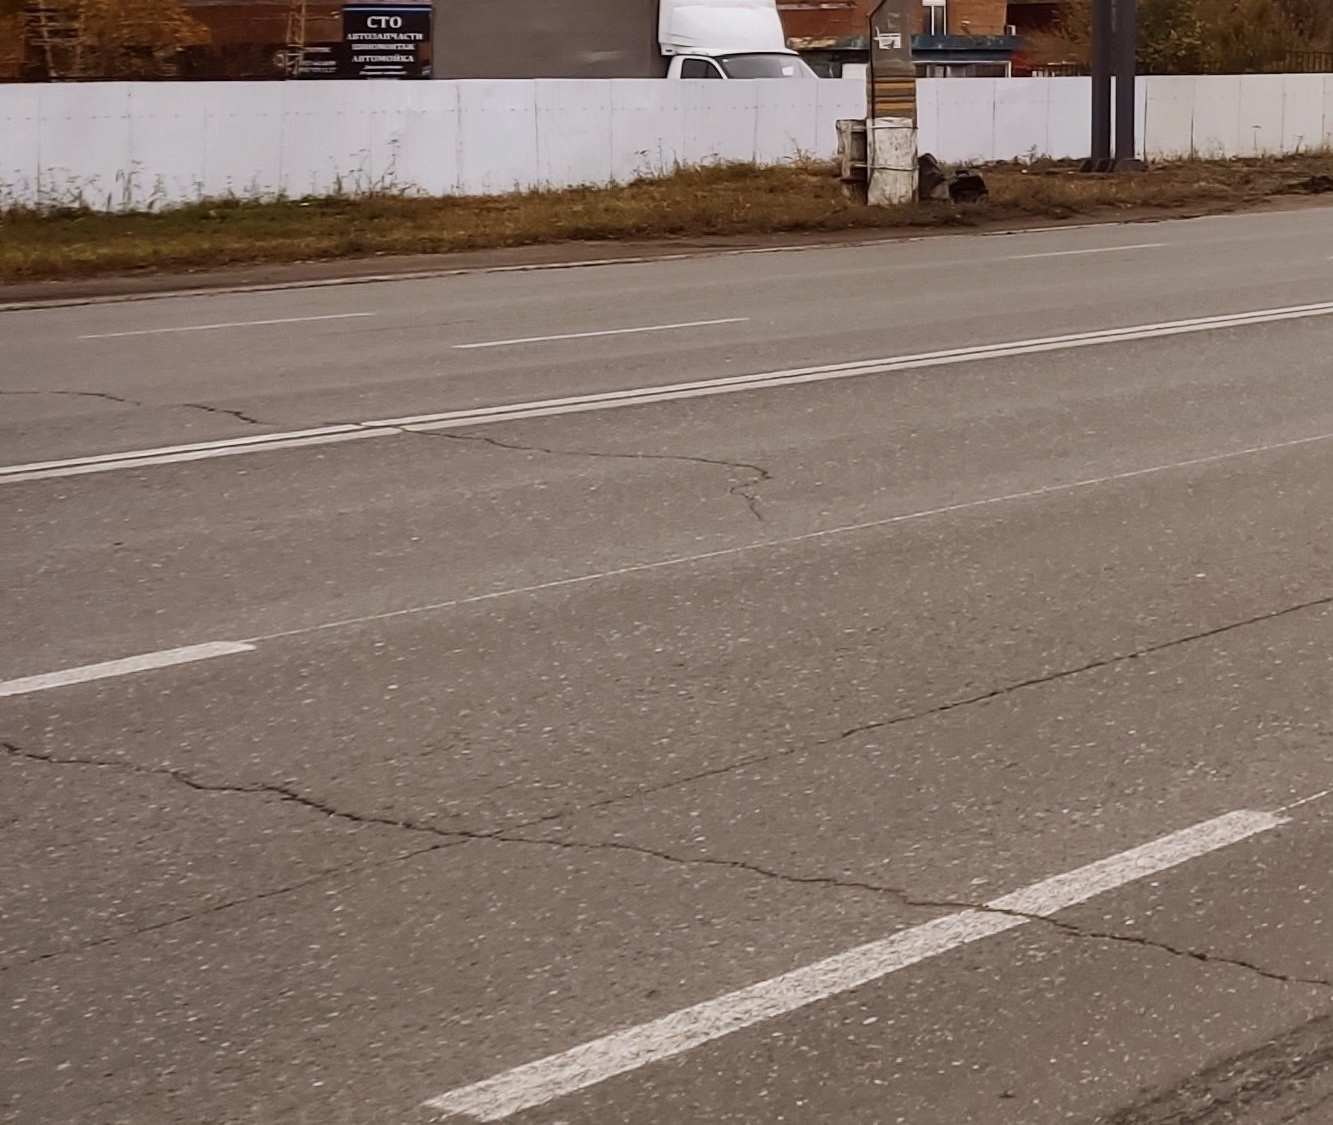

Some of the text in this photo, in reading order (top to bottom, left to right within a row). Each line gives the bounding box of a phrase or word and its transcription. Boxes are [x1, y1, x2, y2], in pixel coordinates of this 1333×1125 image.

[366, 16, 403, 29] СТО
[346, 32, 424, 41] АВТОЗАПЧАСТИ
[352, 53, 415, 63] АВТОМОЙКА
